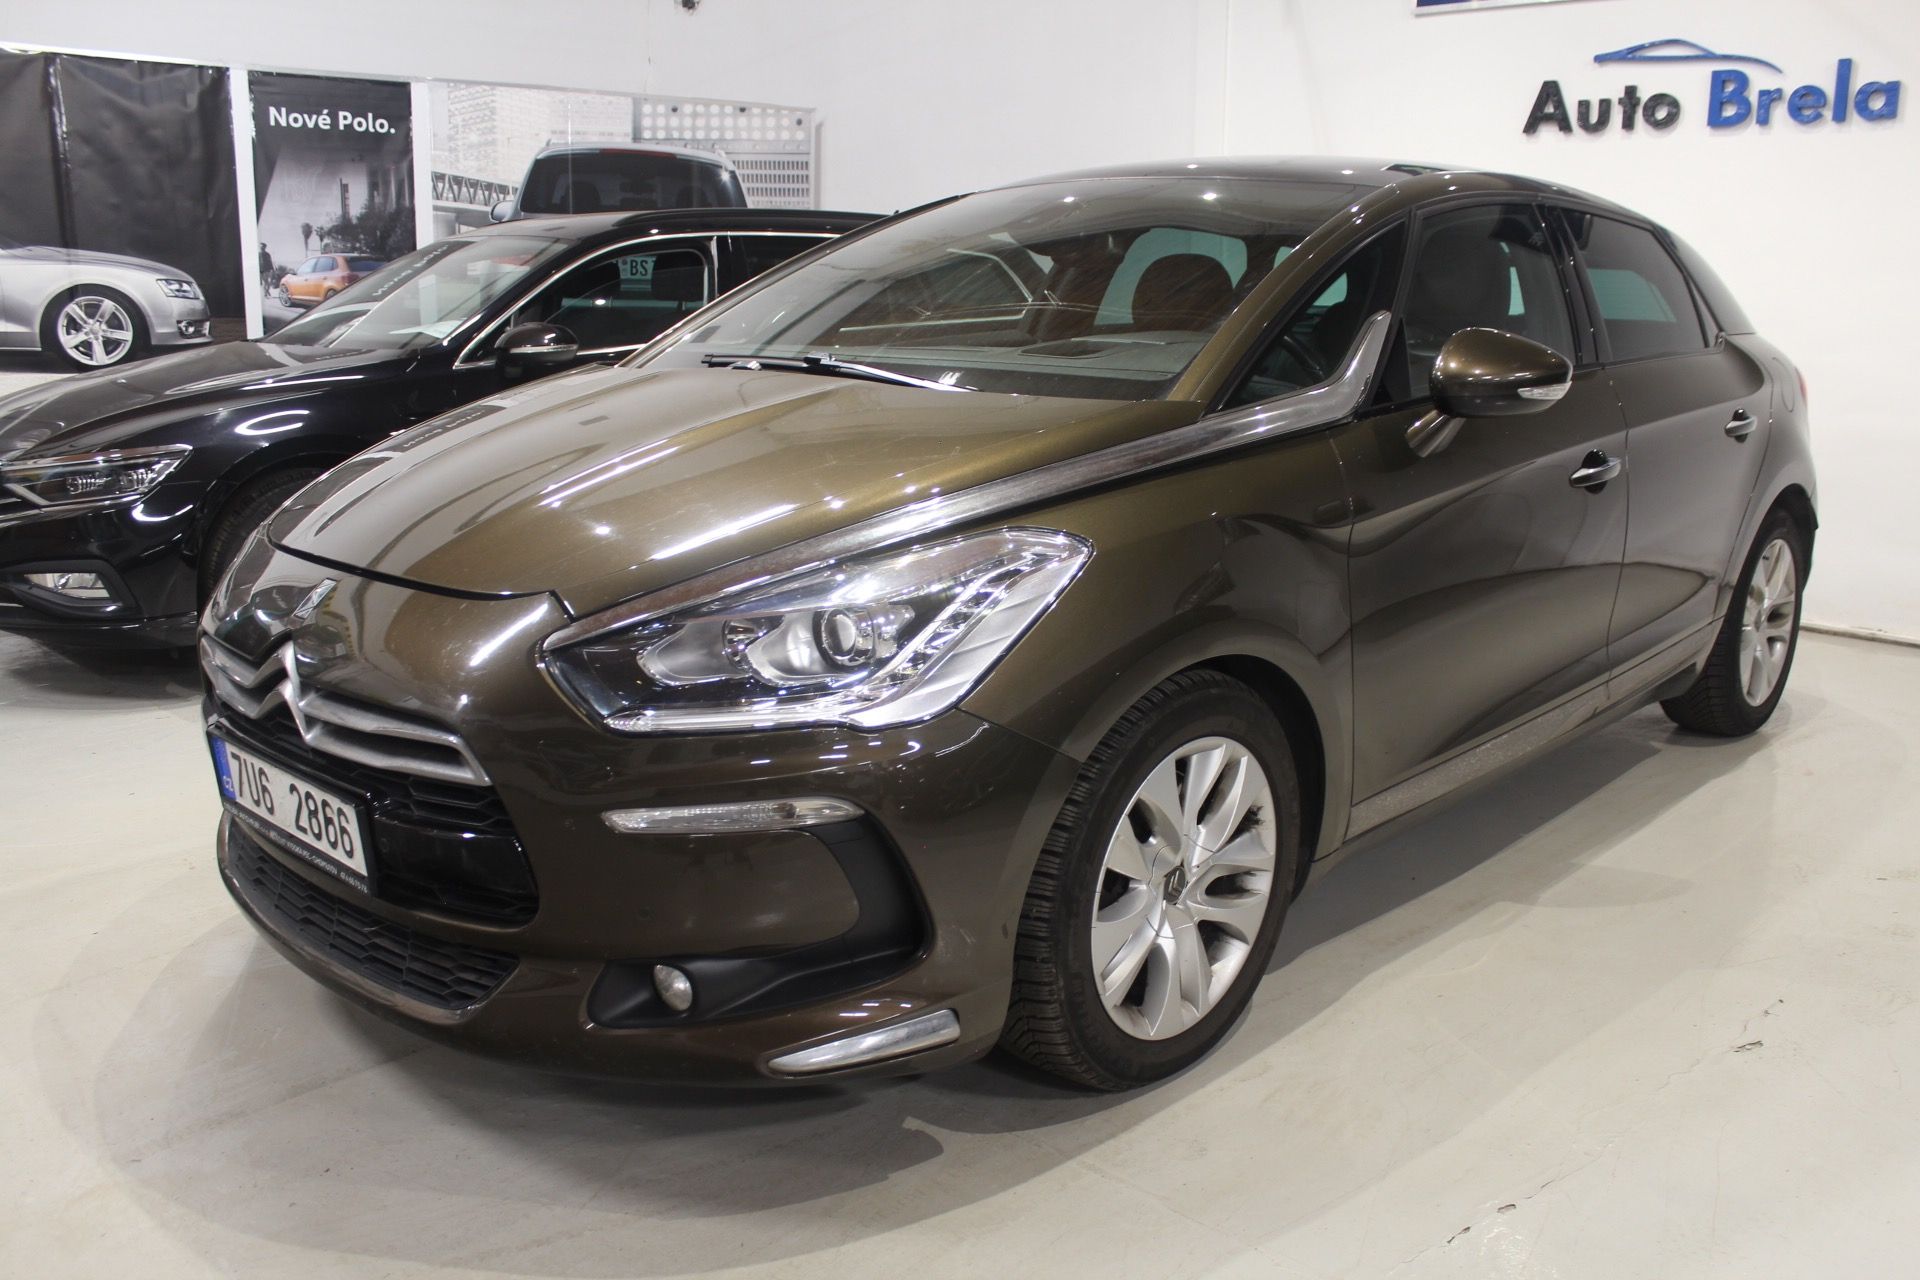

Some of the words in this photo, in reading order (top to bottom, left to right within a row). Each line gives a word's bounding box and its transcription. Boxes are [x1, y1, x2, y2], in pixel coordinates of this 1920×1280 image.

[269, 106, 331, 130] Nové
[338, 110, 396, 134] Polo.
[1523, 80, 1682, 135] Auto
[1707, 58, 1901, 127] Brela
[230, 751, 274, 815] 7U6
[289, 783, 354, 859] 2866
